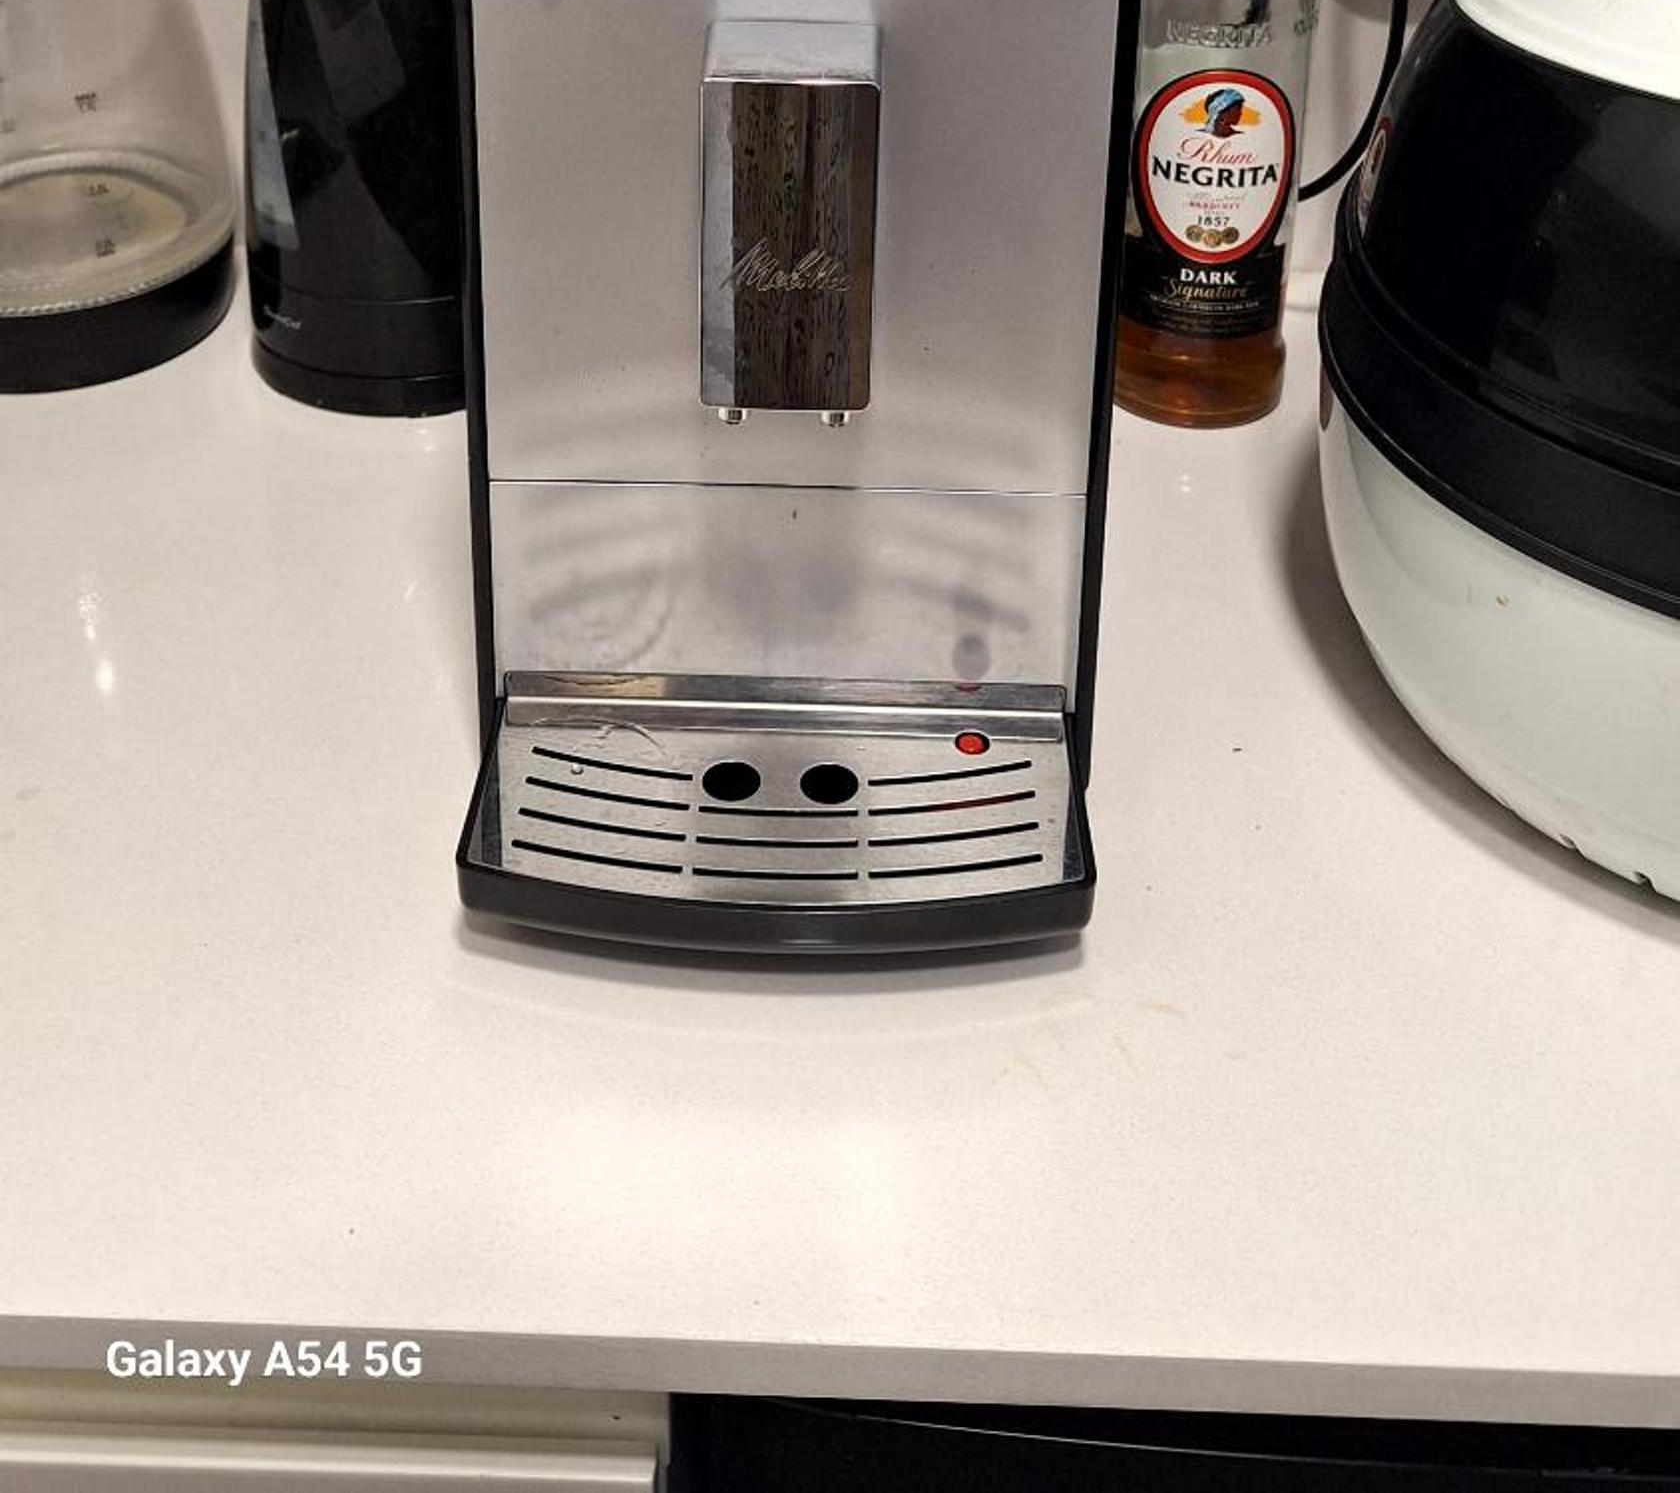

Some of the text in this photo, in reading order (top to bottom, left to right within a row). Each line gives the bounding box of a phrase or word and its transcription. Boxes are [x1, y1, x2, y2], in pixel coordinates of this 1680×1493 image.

[1177, 135, 1258, 165] Rhum
[1152, 155, 1278, 188] NEGRITA
[1197, 215, 1231, 227] 1857
[1163, 277, 1248, 303] Signature
[1179, 268, 1238, 286] DARK
